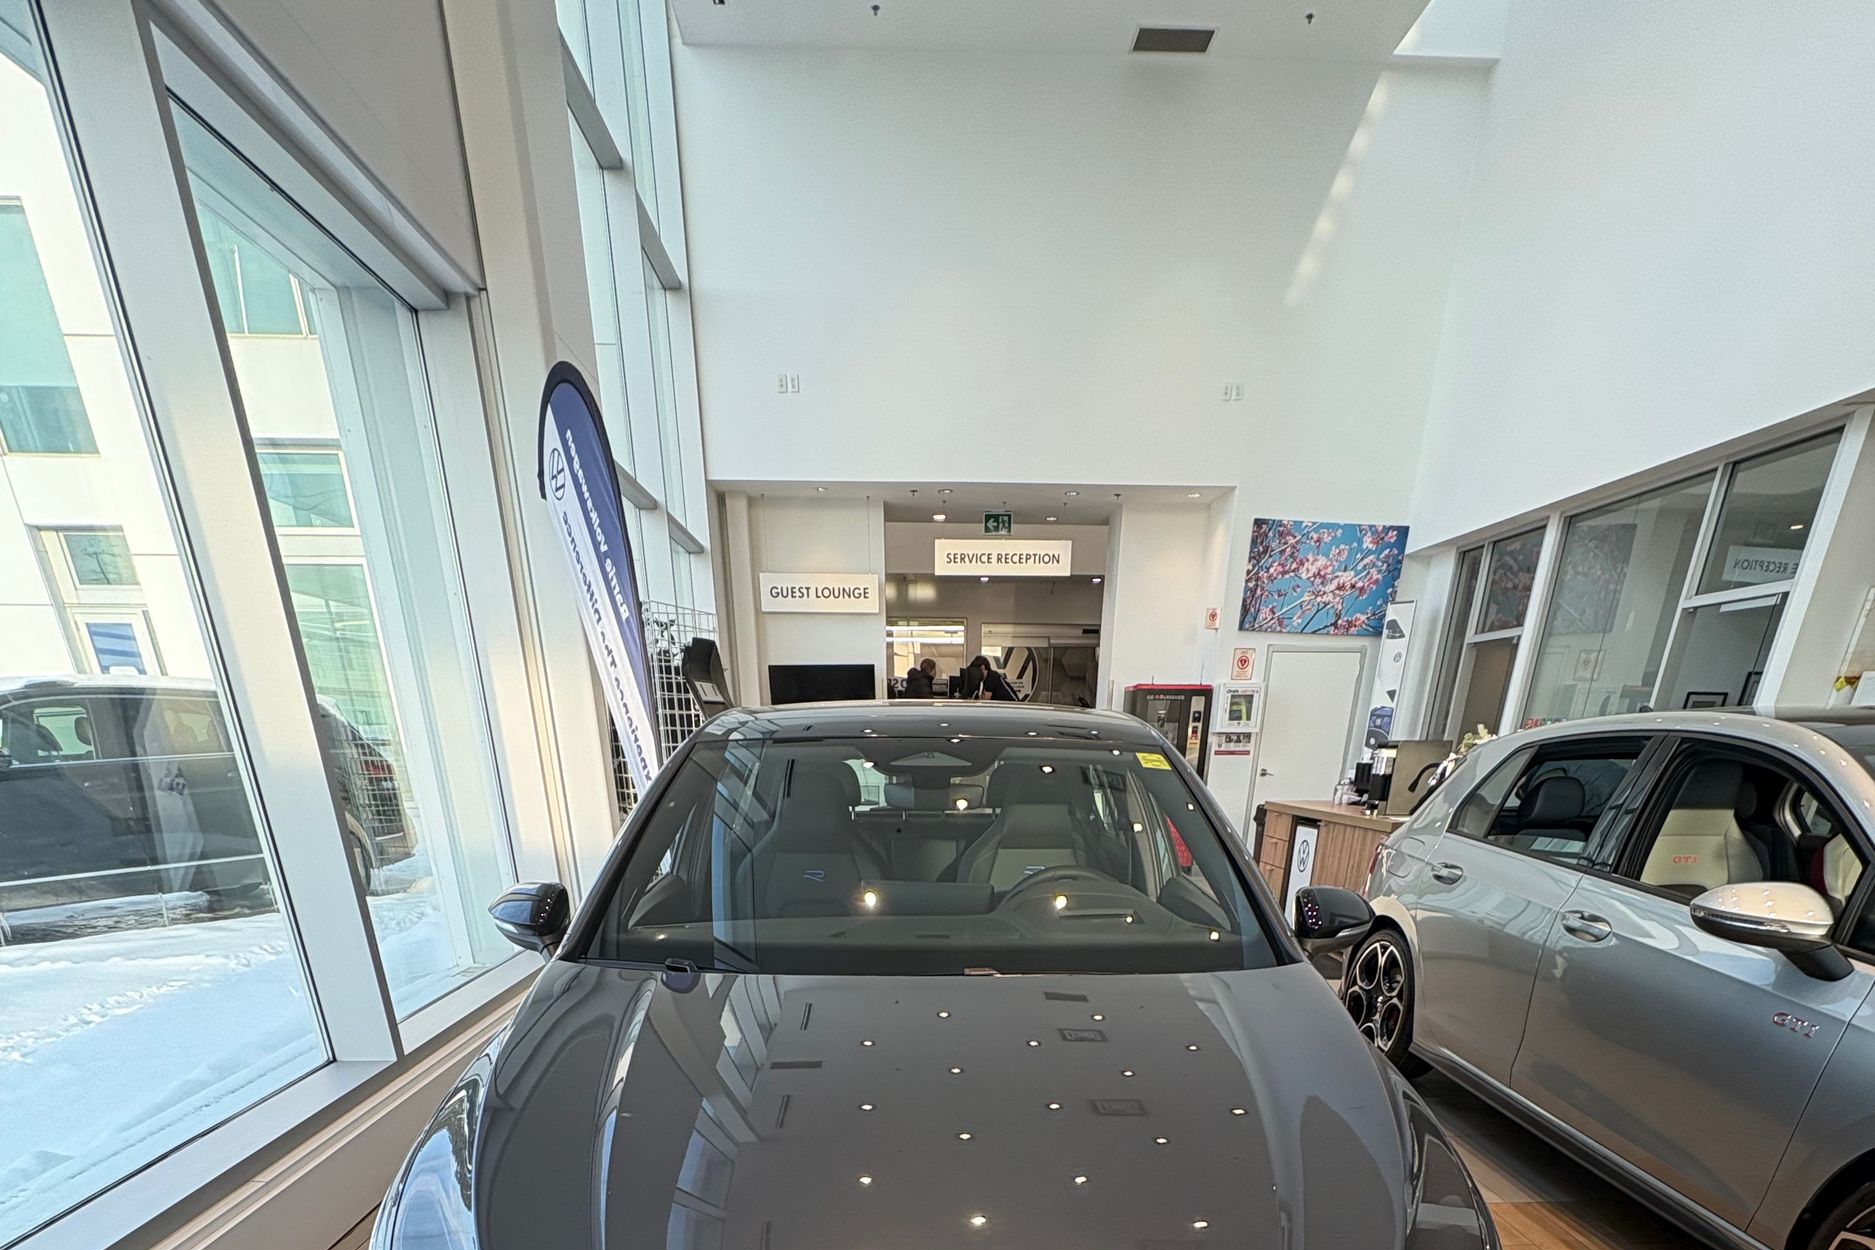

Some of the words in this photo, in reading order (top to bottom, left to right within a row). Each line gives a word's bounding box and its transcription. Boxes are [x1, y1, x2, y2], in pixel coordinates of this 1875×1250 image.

[945, 552, 993, 565] SERVICE
[996, 553, 1061, 566] RECEPTION
[769, 585, 812, 599] GUEST
[815, 586, 870, 600] LOUNGE
[1672, 855, 1698, 865] GTI
[1772, 1010, 1819, 1040] GTI
